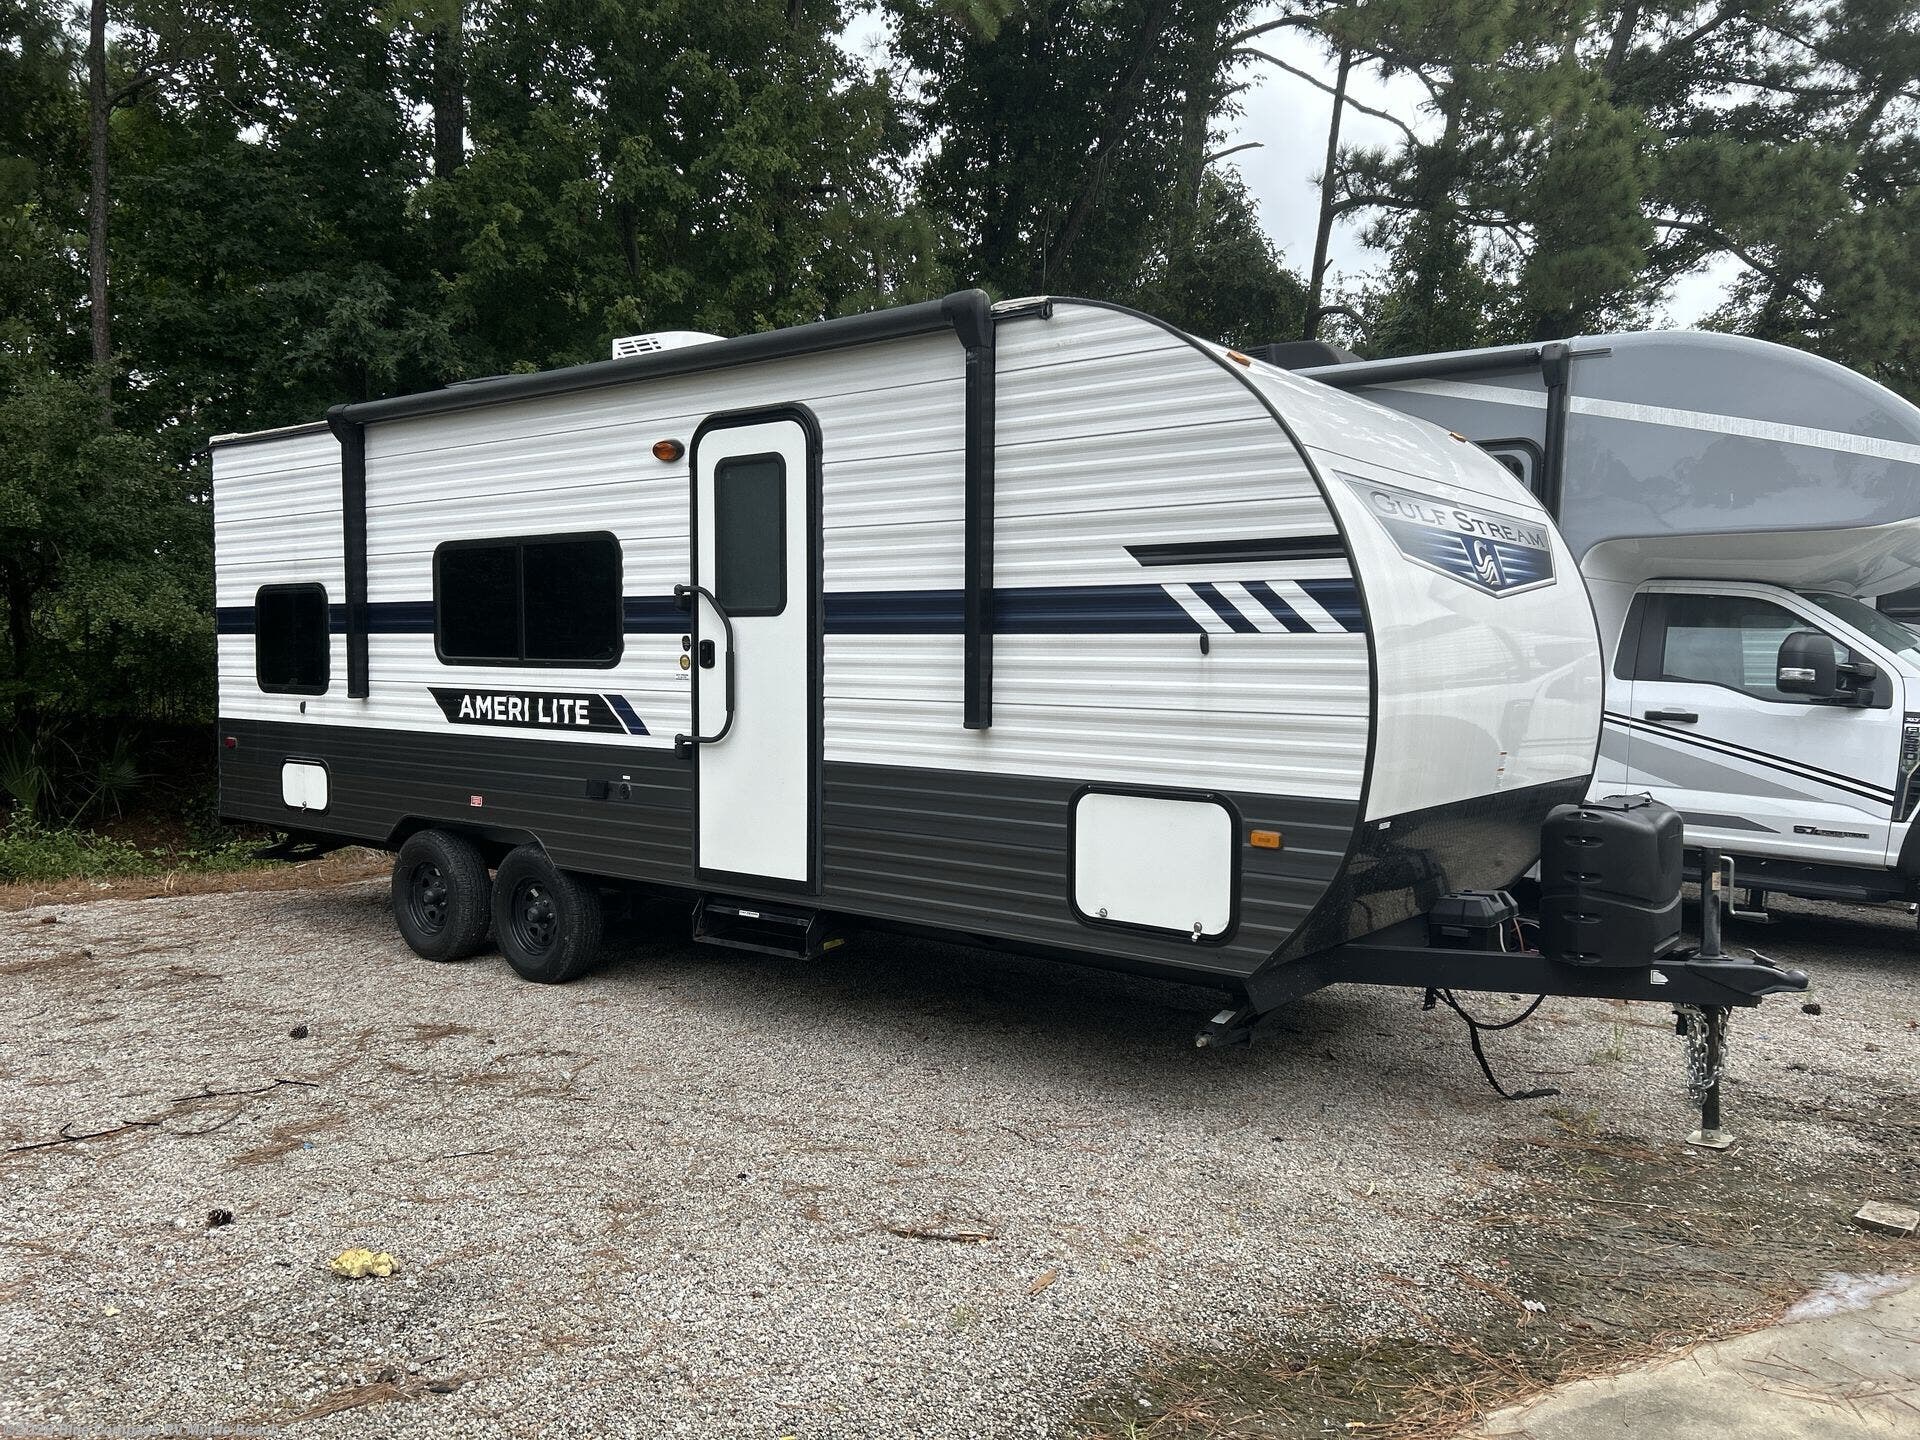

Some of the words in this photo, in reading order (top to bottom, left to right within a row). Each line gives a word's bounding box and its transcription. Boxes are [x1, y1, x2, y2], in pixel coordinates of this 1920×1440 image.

[1370, 491, 1447, 525] GULF
[1452, 511, 1546, 548] STREAM
[458, 694, 531, 722] AMERI
[537, 698, 590, 725] LITE
